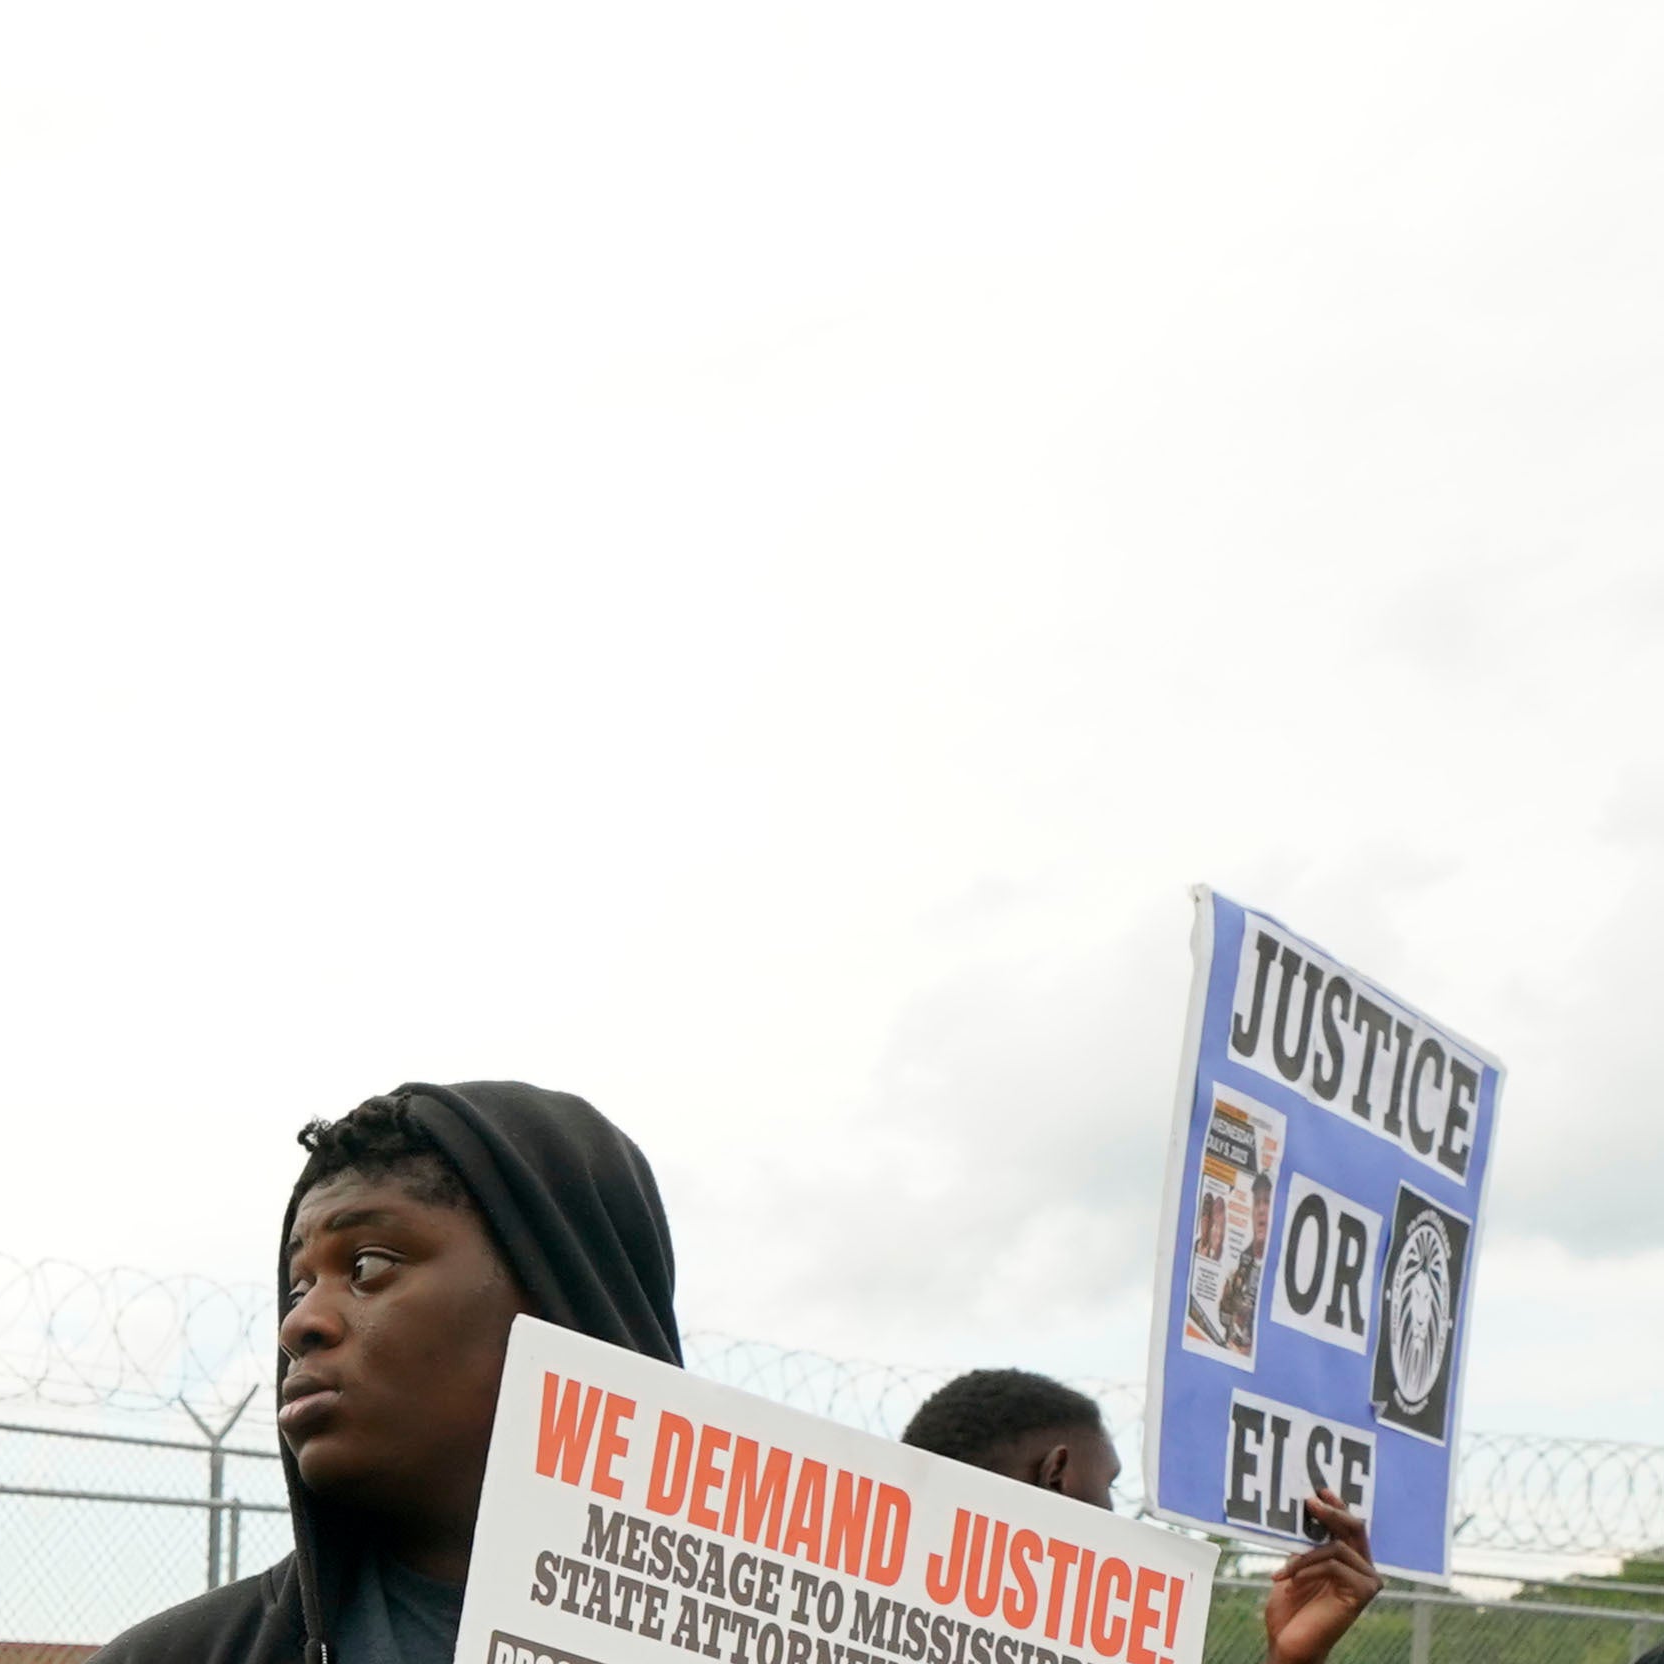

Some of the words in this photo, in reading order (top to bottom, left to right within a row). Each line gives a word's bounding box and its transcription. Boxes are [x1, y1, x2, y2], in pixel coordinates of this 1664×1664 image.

[1231, 930, 1479, 1178] JUSTICE
[1284, 1193, 1367, 1336] OR
[535, 1371, 637, 1500] WE
[645, 1409, 912, 1587] DEMAND
[1226, 1403, 1371, 1542] ELSE
[530, 1550, 669, 1641] STATE
[581, 1503, 785, 1615] MESSAGE
[791, 1569, 844, 1633] TO
